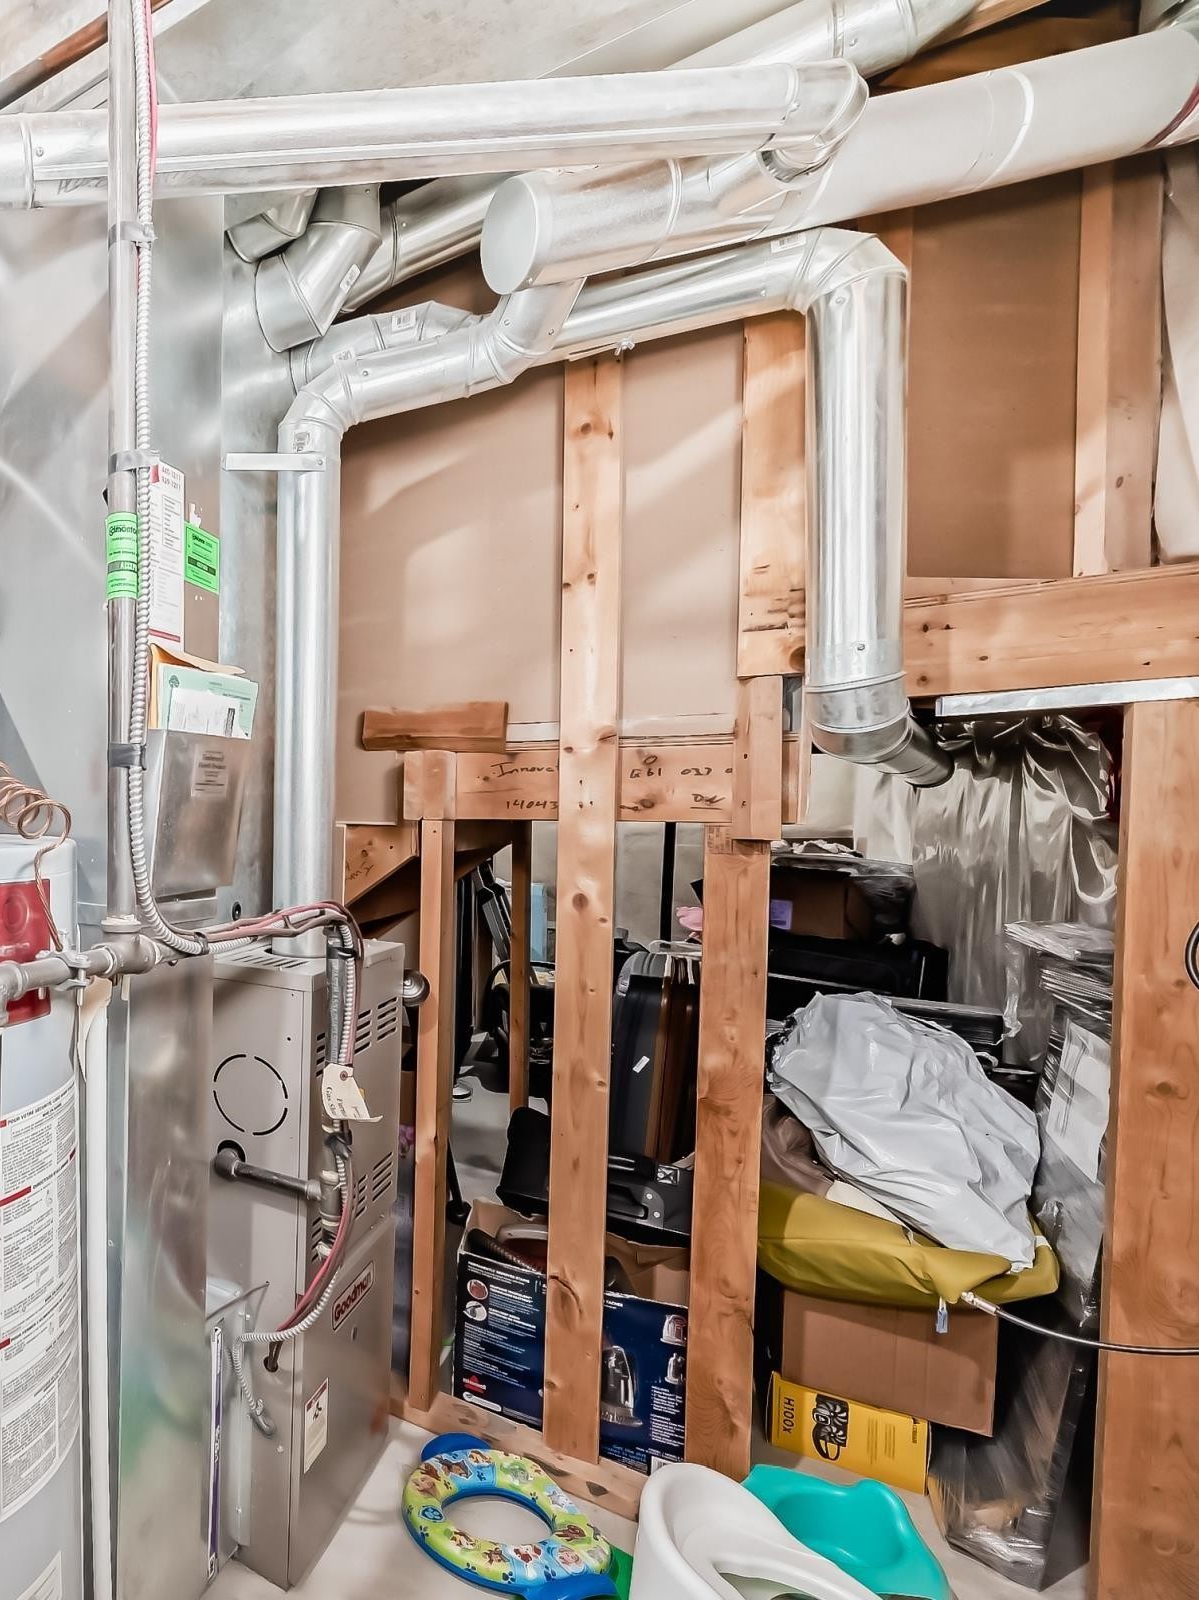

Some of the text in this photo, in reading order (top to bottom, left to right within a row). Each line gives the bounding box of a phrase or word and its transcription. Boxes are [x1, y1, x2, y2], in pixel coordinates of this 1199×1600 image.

[109, 526, 137, 536] Edmonto
[334, 1271, 372, 1322] Goodman
[781, 1397, 795, 1435] H100x
